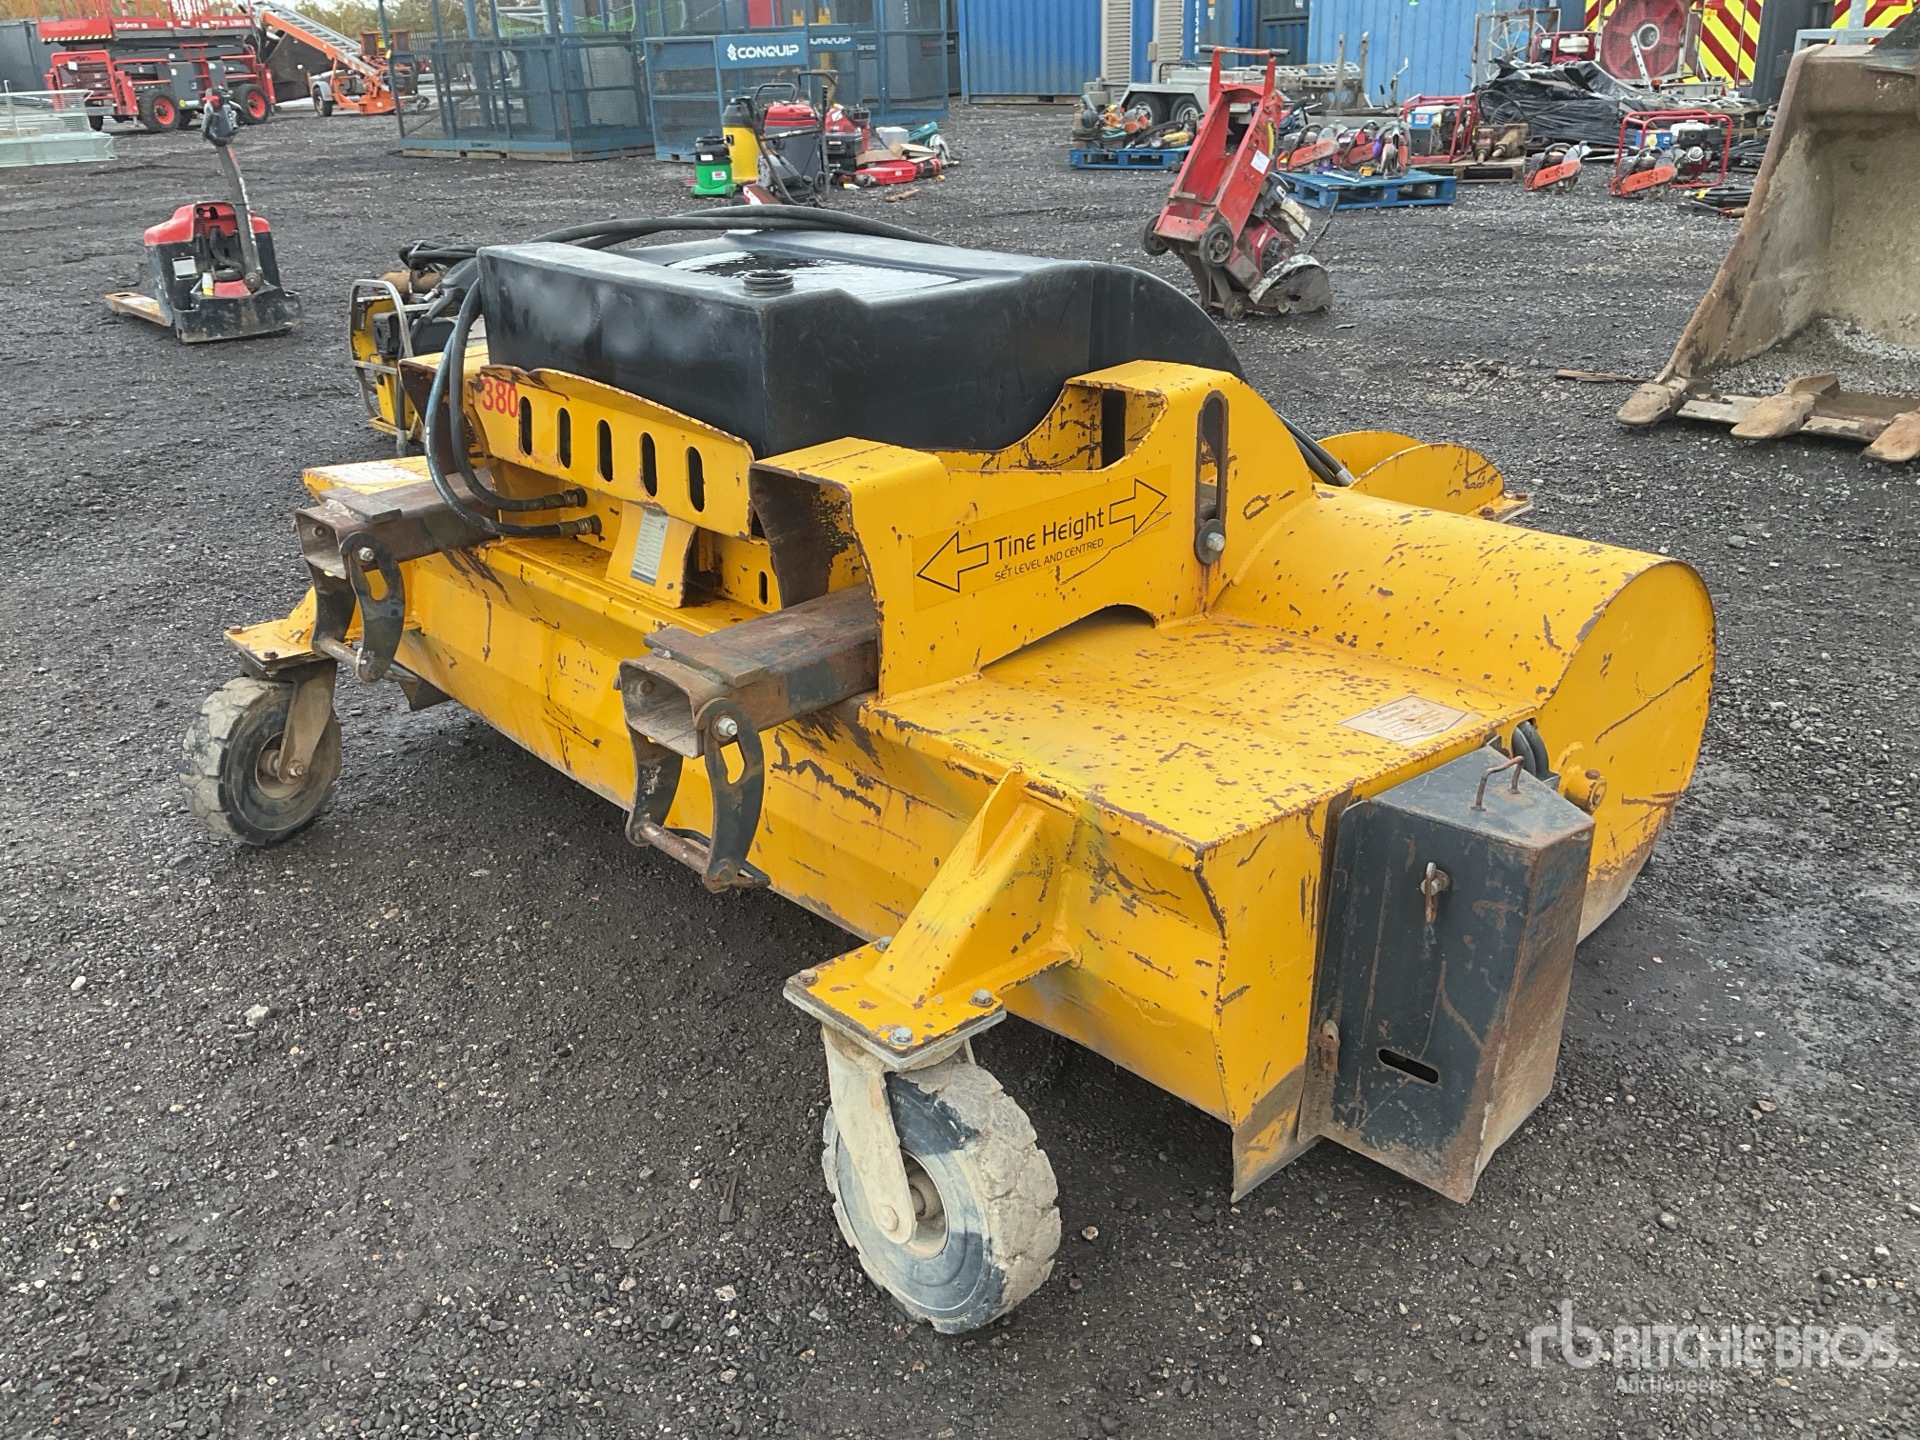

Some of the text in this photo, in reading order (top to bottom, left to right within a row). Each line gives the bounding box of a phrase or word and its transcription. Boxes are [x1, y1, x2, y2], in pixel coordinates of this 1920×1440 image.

[736, 44, 800, 59] CONQUIP
[480, 376, 518, 418] 380
[993, 507, 1105, 560] Tine Height
[994, 537, 1104, 581] SET LEVEL AND CENTRED
